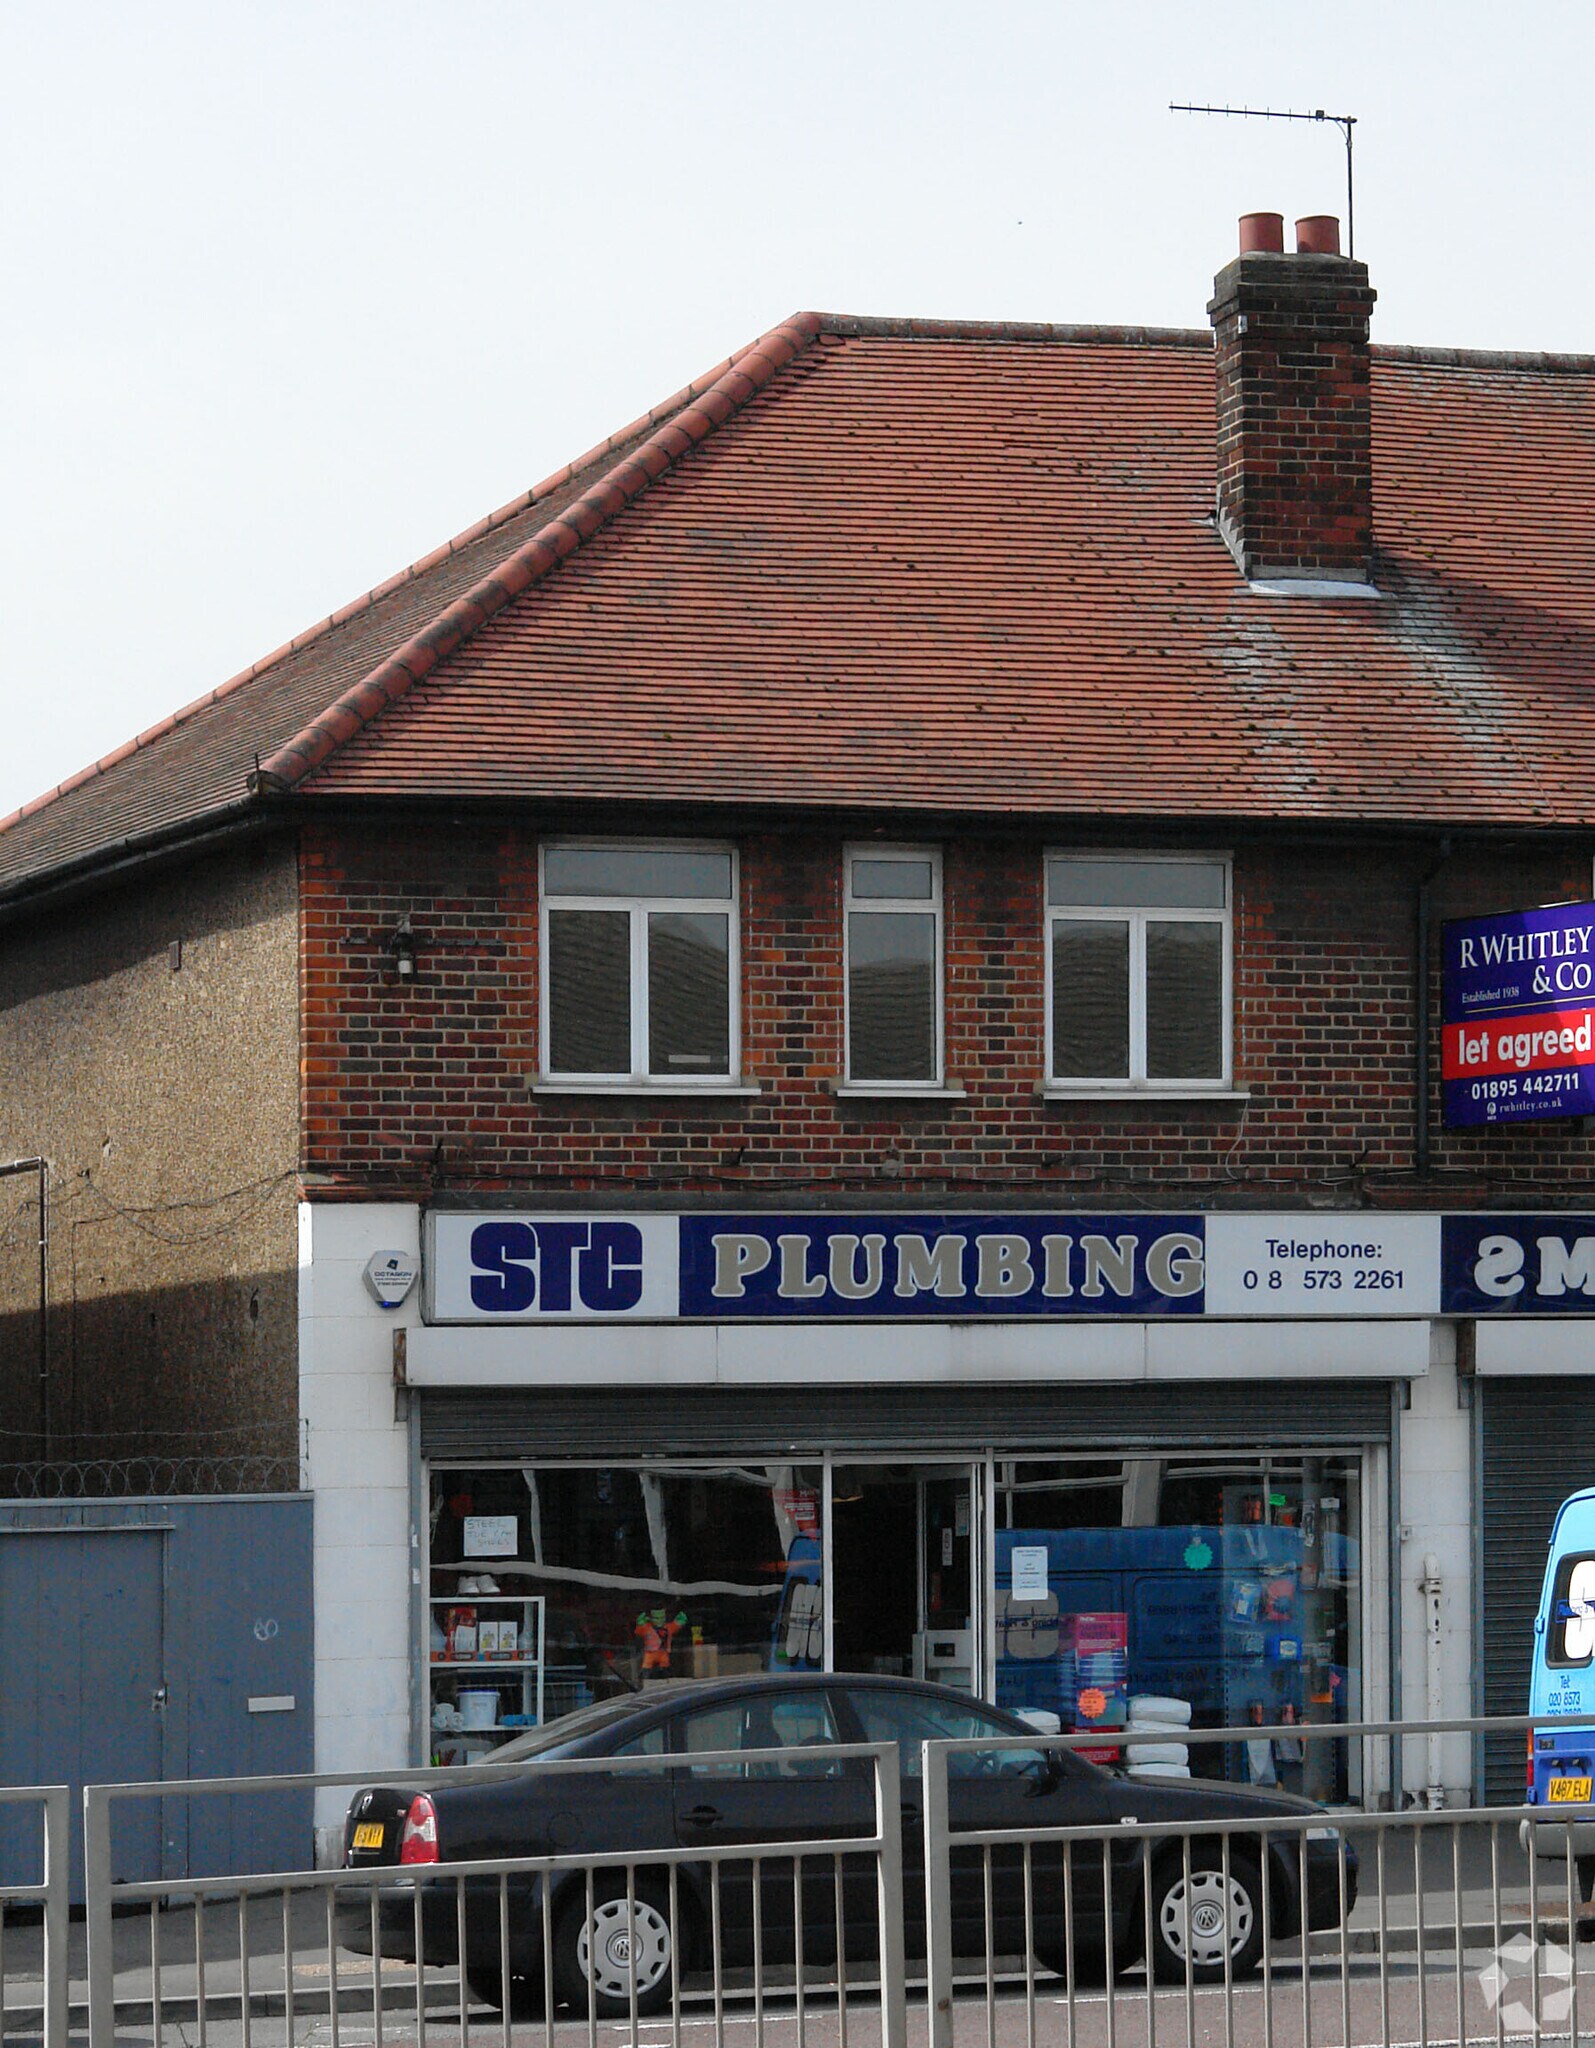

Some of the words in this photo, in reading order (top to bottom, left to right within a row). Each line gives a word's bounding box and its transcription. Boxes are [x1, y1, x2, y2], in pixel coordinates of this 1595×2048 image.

[1460, 938, 1479, 969] R
[1480, 926, 1594, 966] WHITLEY
[1532, 965, 1554, 994] &
[1462, 988, 1501, 1003] Established
[1502, 986, 1520, 999] 1938
[1459, 1029, 1490, 1065] let
[1497, 1013, 1592, 1068] agreed
[1471, 1079, 1518, 1100] 01895
[1522, 1072, 1579, 1095] 442711
[1499, 1097, 1562, 1113] rwhitley.co.uk
[1265, 1239, 1382, 1262] Telephone:
[470, 1222, 643, 1311] STC
[711, 1232, 1204, 1299] PLUMBING
[1303, 1270, 1342, 1290] 573
[1354, 1270, 1403, 1290] 2261
